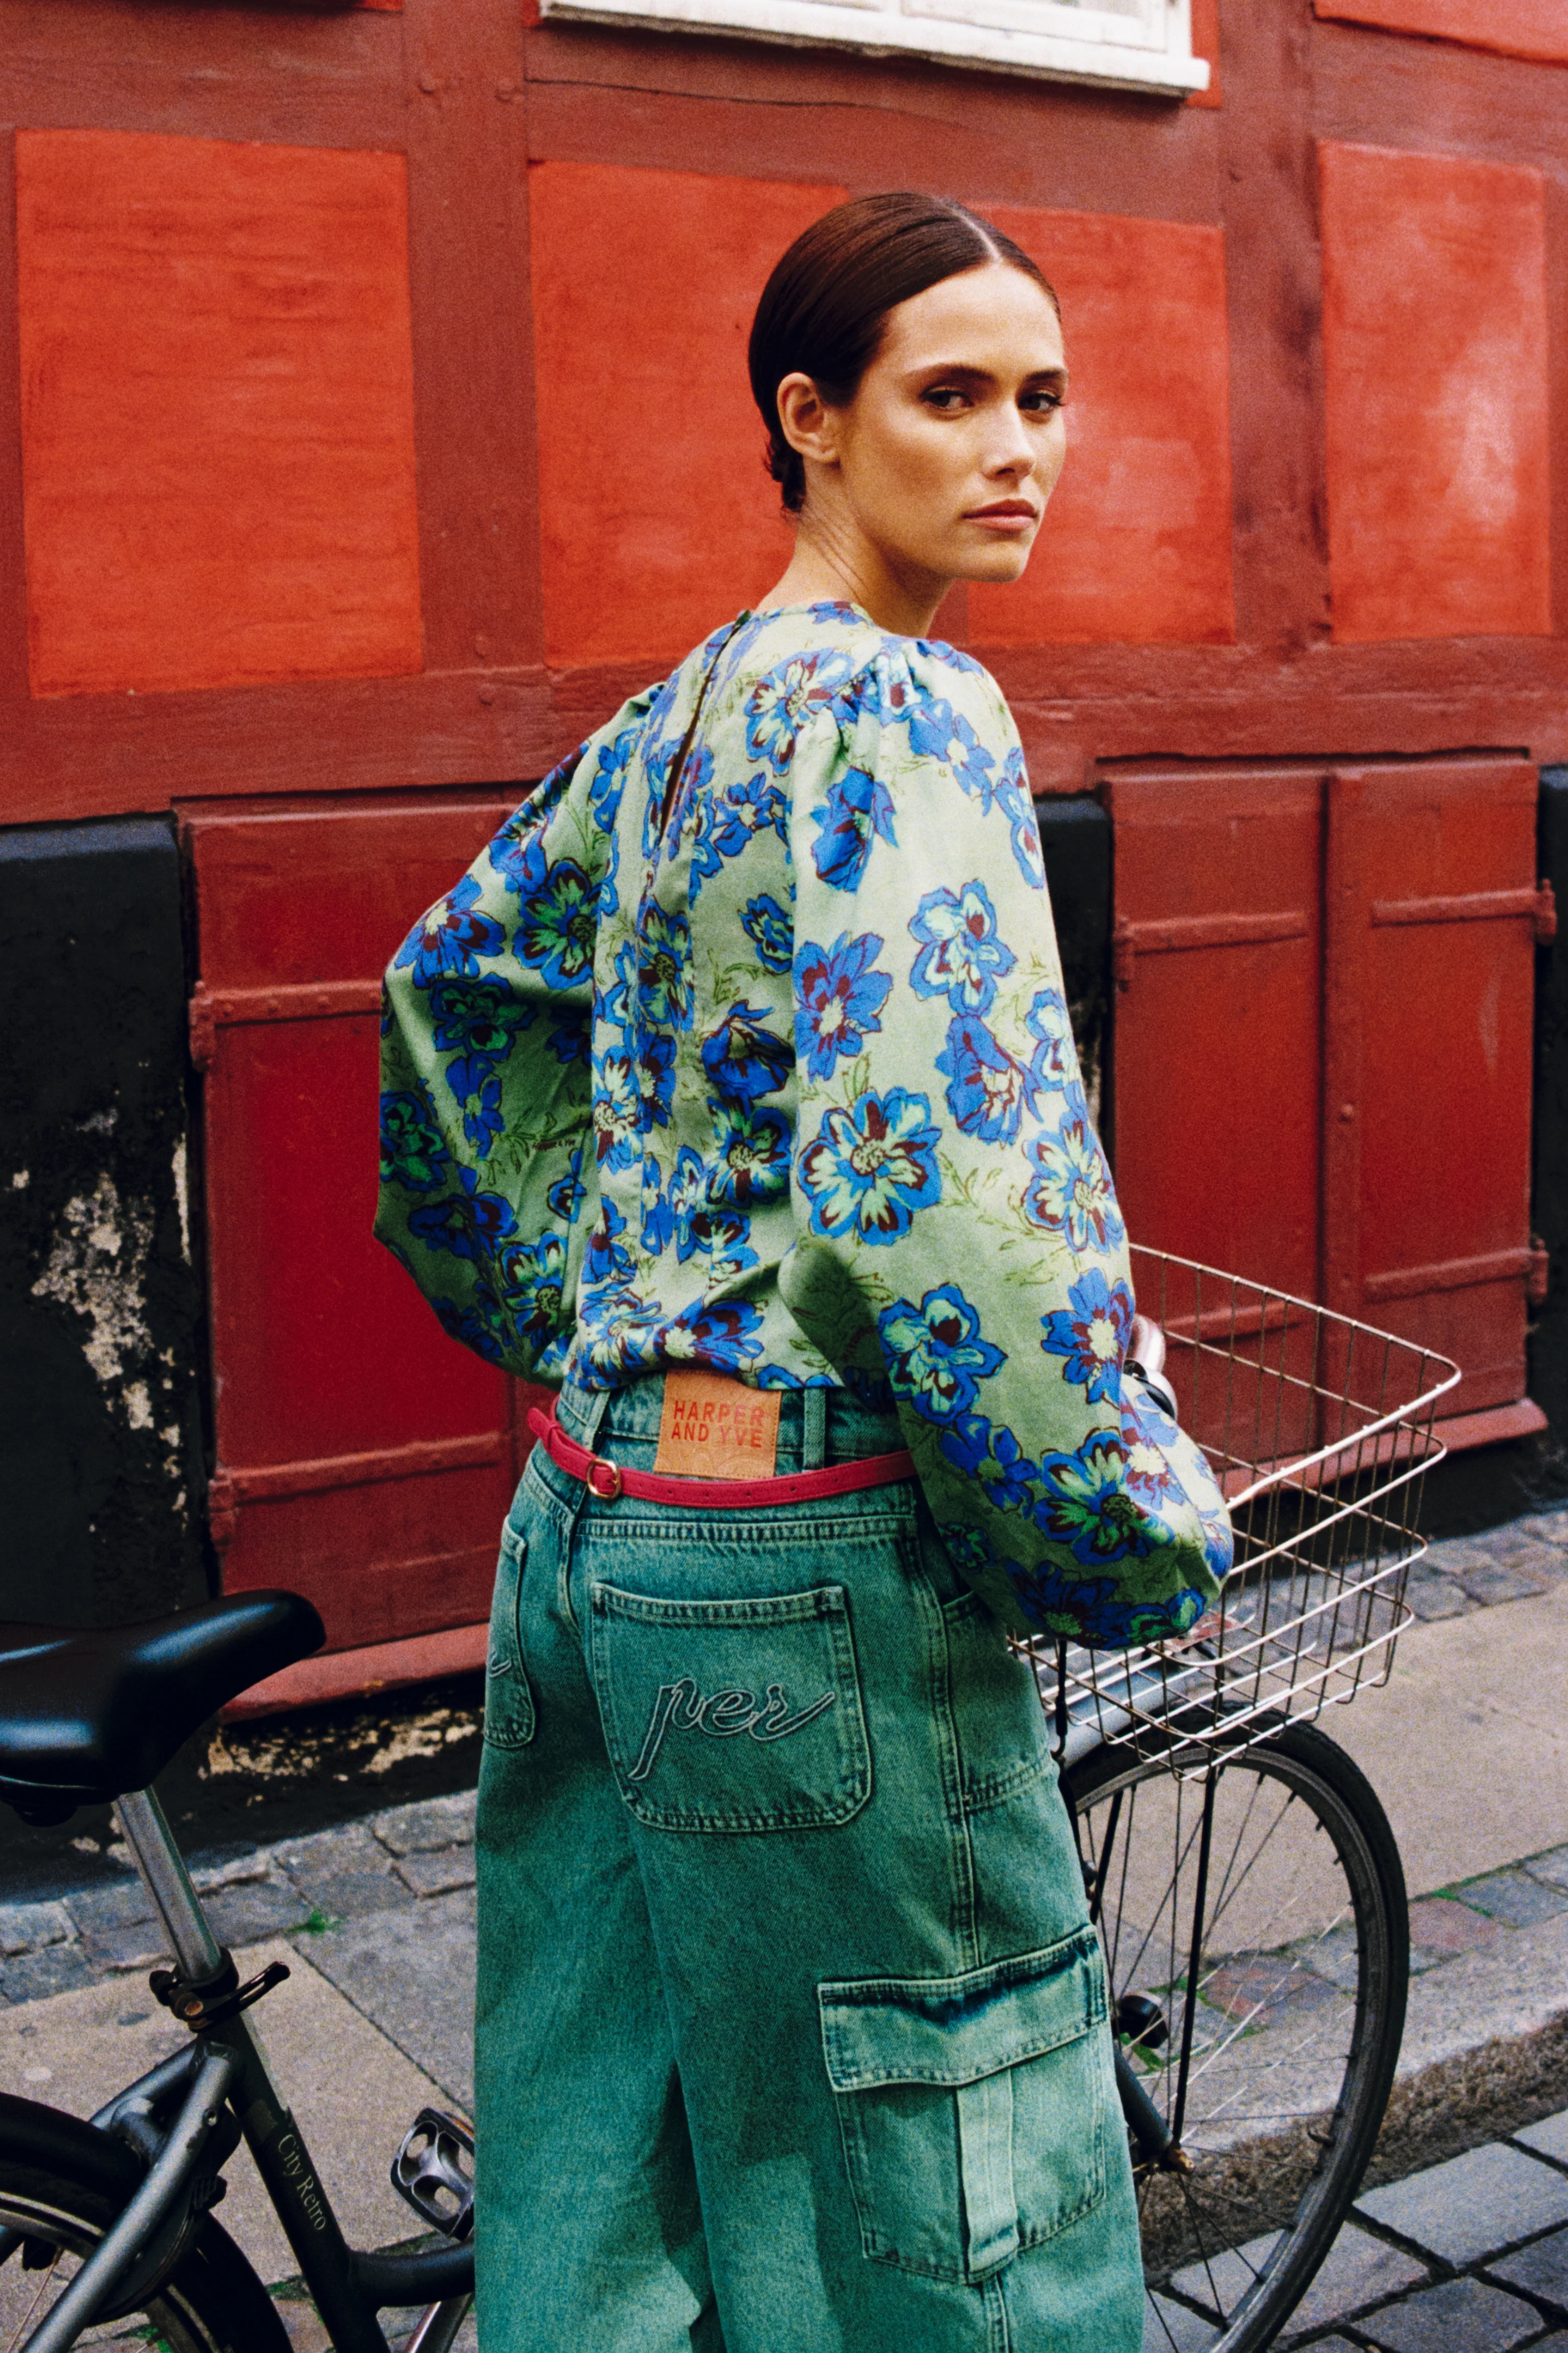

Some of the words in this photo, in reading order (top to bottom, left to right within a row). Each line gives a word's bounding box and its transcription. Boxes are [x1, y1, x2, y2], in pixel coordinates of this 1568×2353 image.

[673, 1400, 765, 1426] HARPER
[671, 1422, 709, 1442] AND
[720, 1425, 763, 1448] YVE
[278, 2134, 303, 2176] City
[297, 2175, 326, 2230] Retro
